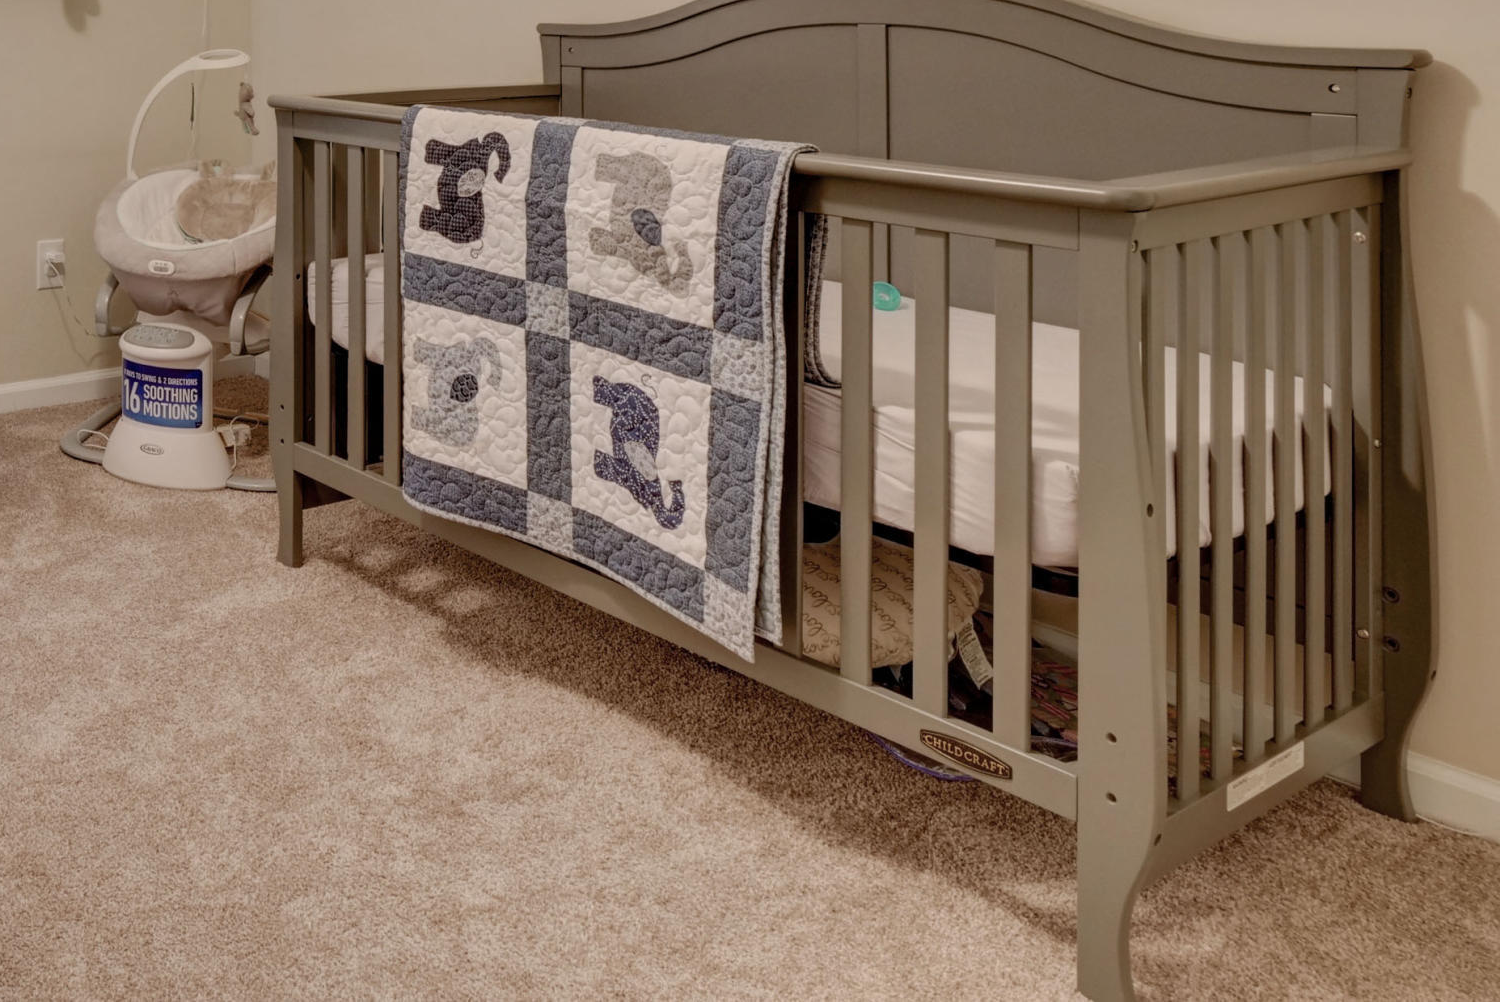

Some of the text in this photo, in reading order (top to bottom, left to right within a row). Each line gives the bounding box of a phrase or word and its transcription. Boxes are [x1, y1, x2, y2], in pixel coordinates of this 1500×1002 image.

[167, 377, 198, 386] DIRECTIONS
[123, 379, 198, 414] 16 SOOTHING
[143, 400, 198, 420] MOTIONS
